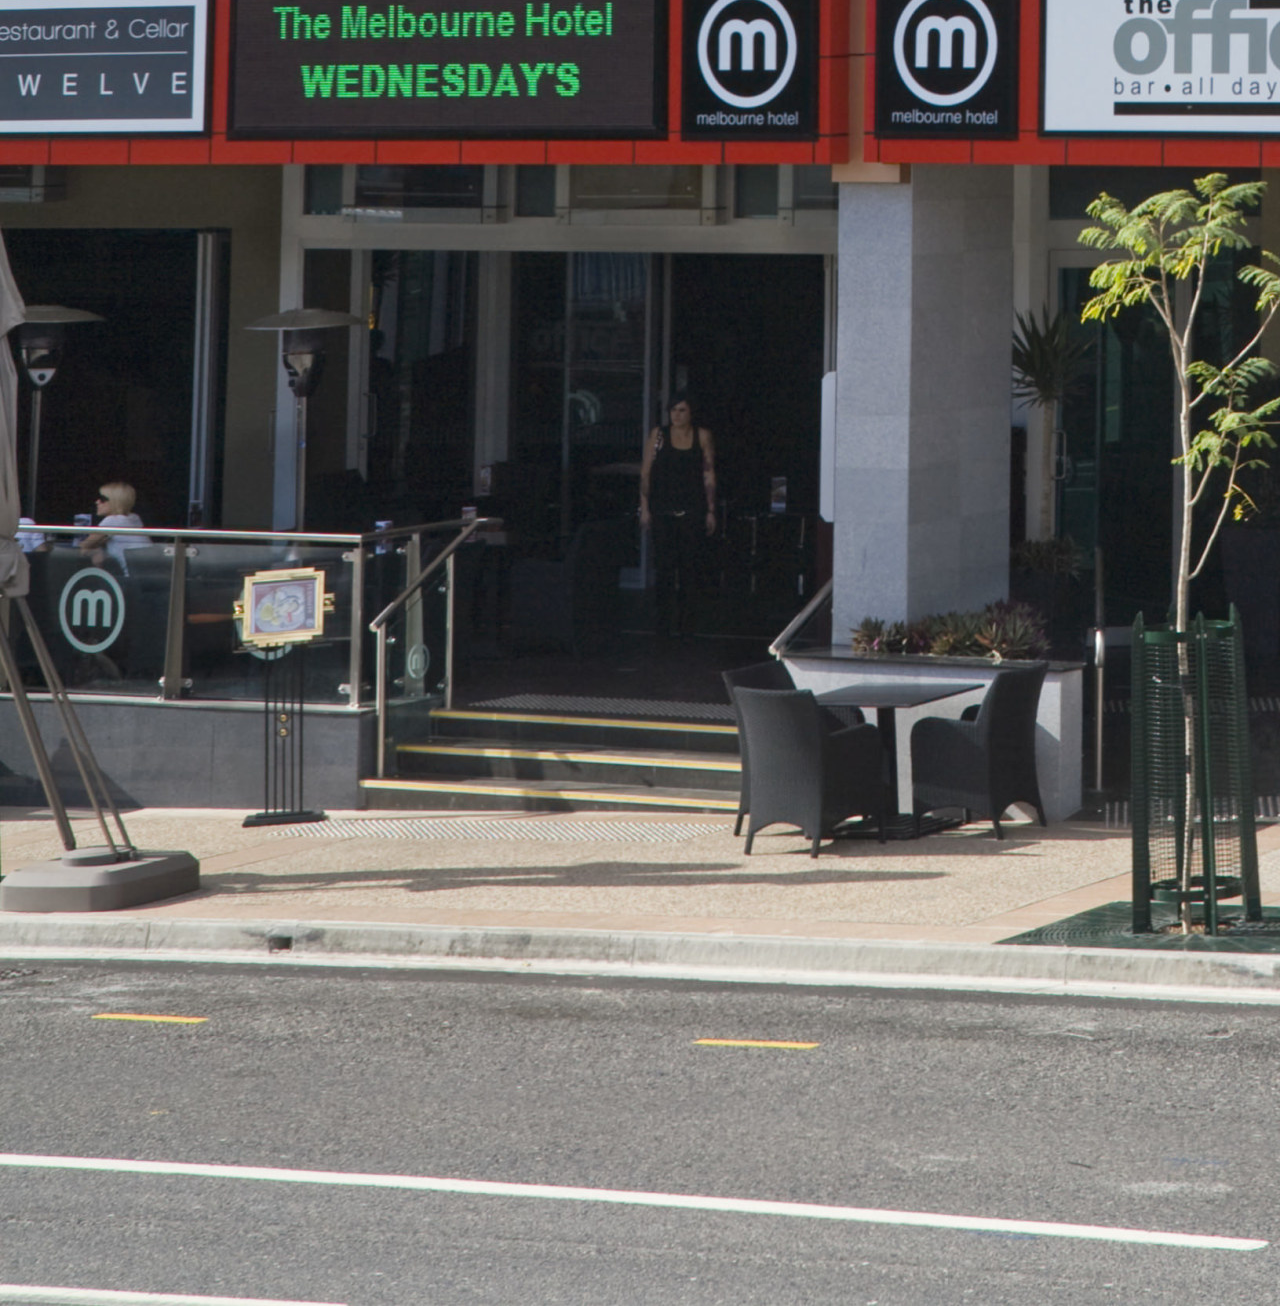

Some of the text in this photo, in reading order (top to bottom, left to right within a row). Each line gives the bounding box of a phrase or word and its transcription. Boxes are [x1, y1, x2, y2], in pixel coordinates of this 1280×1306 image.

[104, 19, 119, 39] &
[128, 19, 189, 38] Cellar
[273, 2, 613, 39] The Melbourne Hotel
[301, 63, 580, 98] WEDNESDAY'S
[1232, 77, 1277, 100] day
[697, 111, 799, 126] melbourne hotel
[891, 109, 998, 125] melbourne hotel
